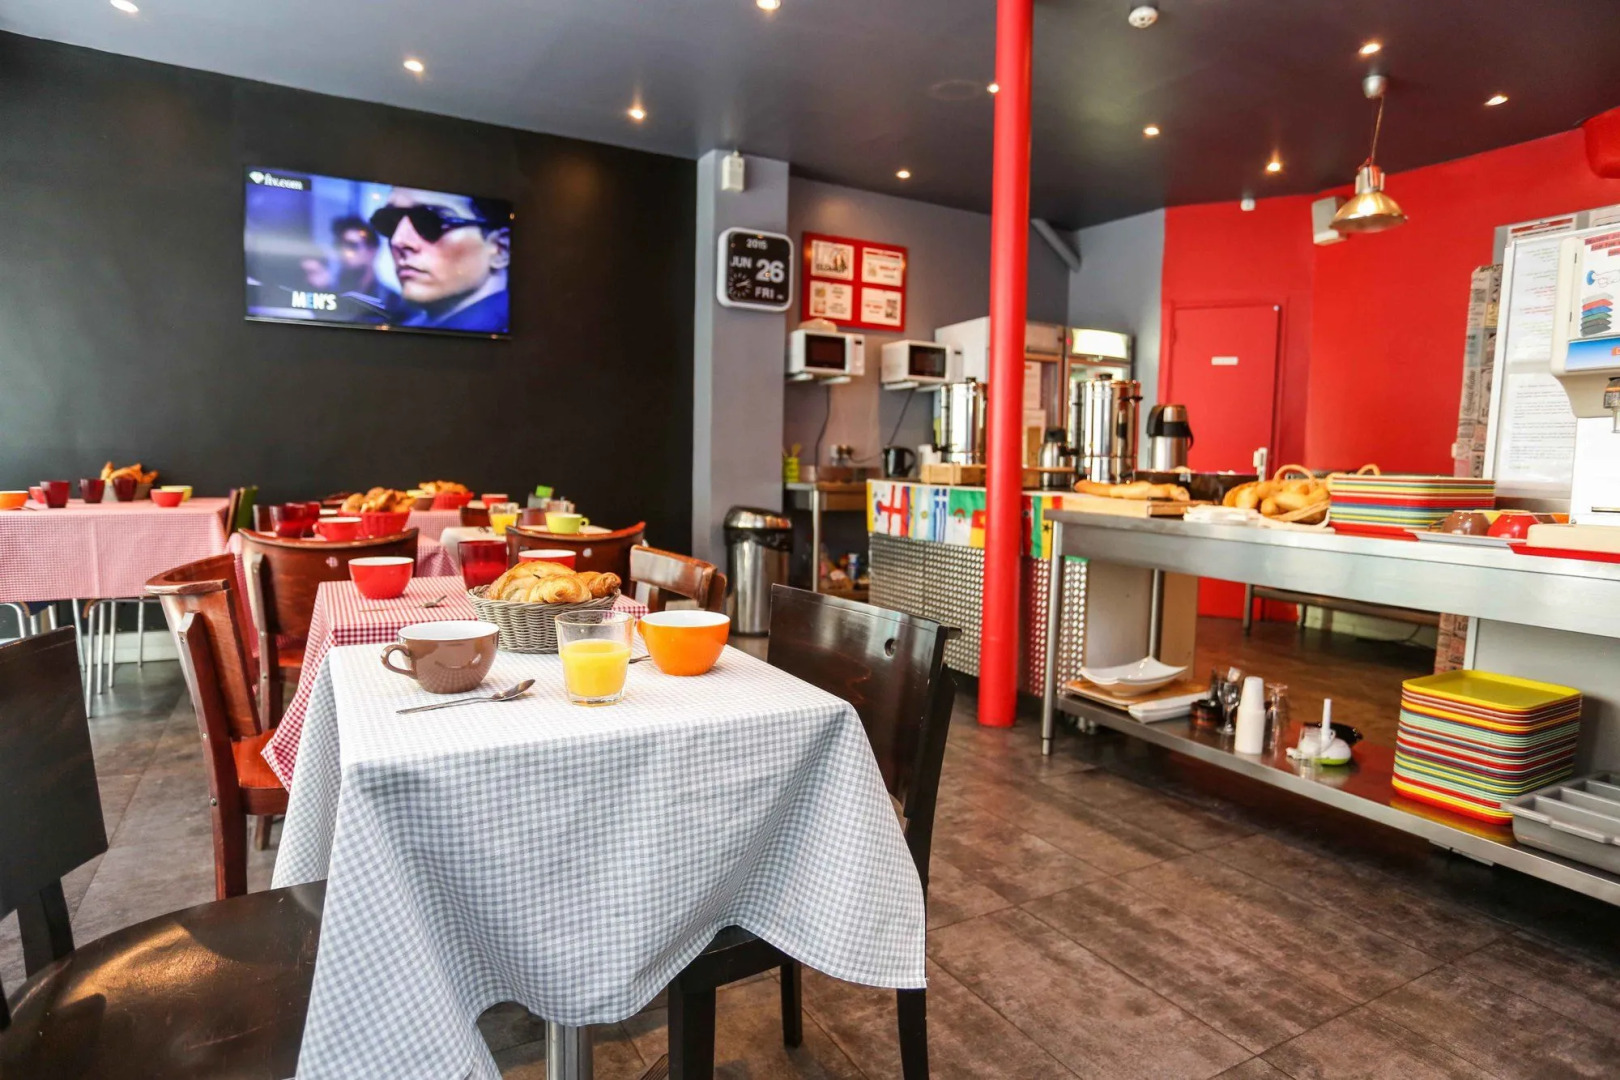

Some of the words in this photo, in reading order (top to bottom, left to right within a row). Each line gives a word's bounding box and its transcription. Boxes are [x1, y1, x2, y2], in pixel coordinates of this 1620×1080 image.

[730, 255, 752, 268] JUN
[756, 258, 785, 283] 26
[755, 286, 775, 299] FRI
